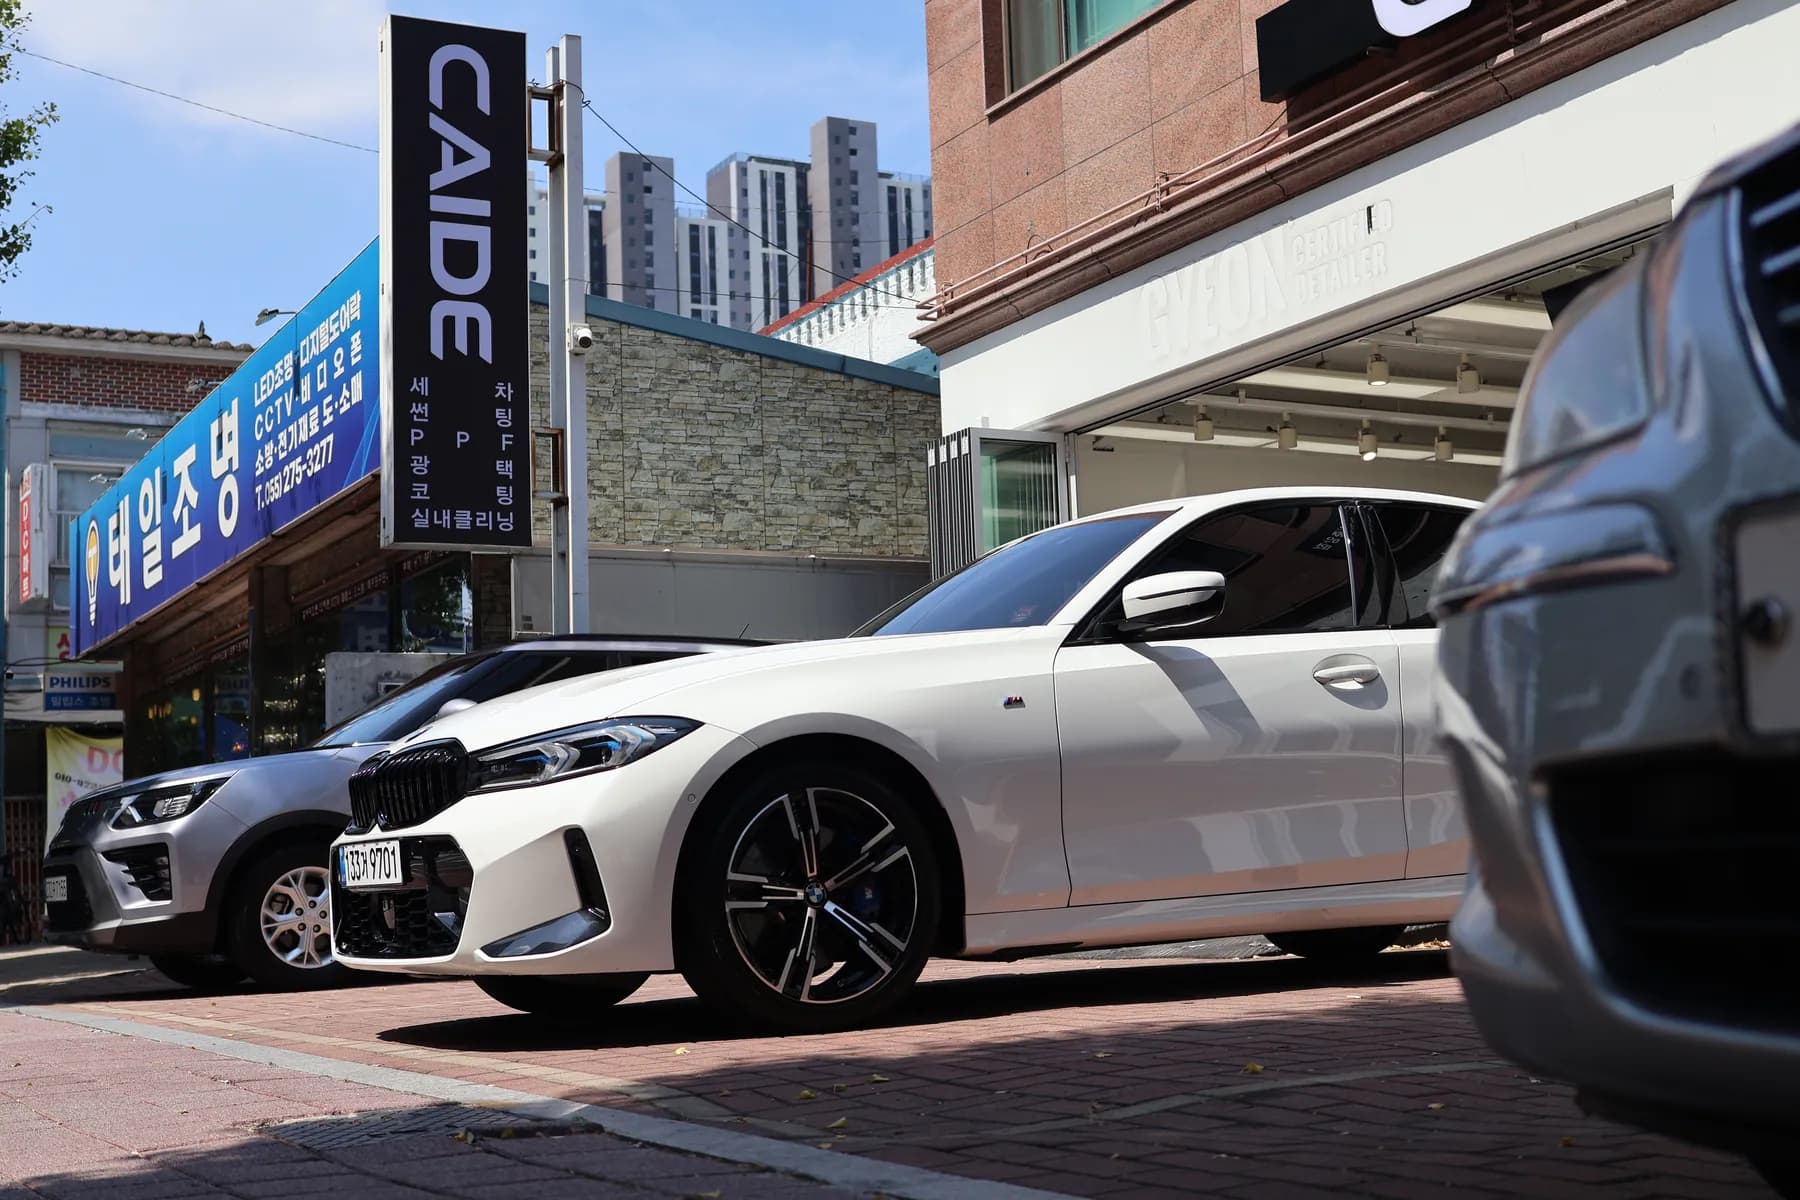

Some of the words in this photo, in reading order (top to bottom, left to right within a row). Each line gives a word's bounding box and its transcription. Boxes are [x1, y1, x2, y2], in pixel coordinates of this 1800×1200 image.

[429, 44, 492, 365] CAIDE
[1297, 241, 1388, 305] DETAILER
[254, 350, 294, 408] LED조명
[300, 290, 362, 369] 디지털도어락
[108, 397, 239, 605] 태일조명
[50, 676, 111, 689] PHILIPS
